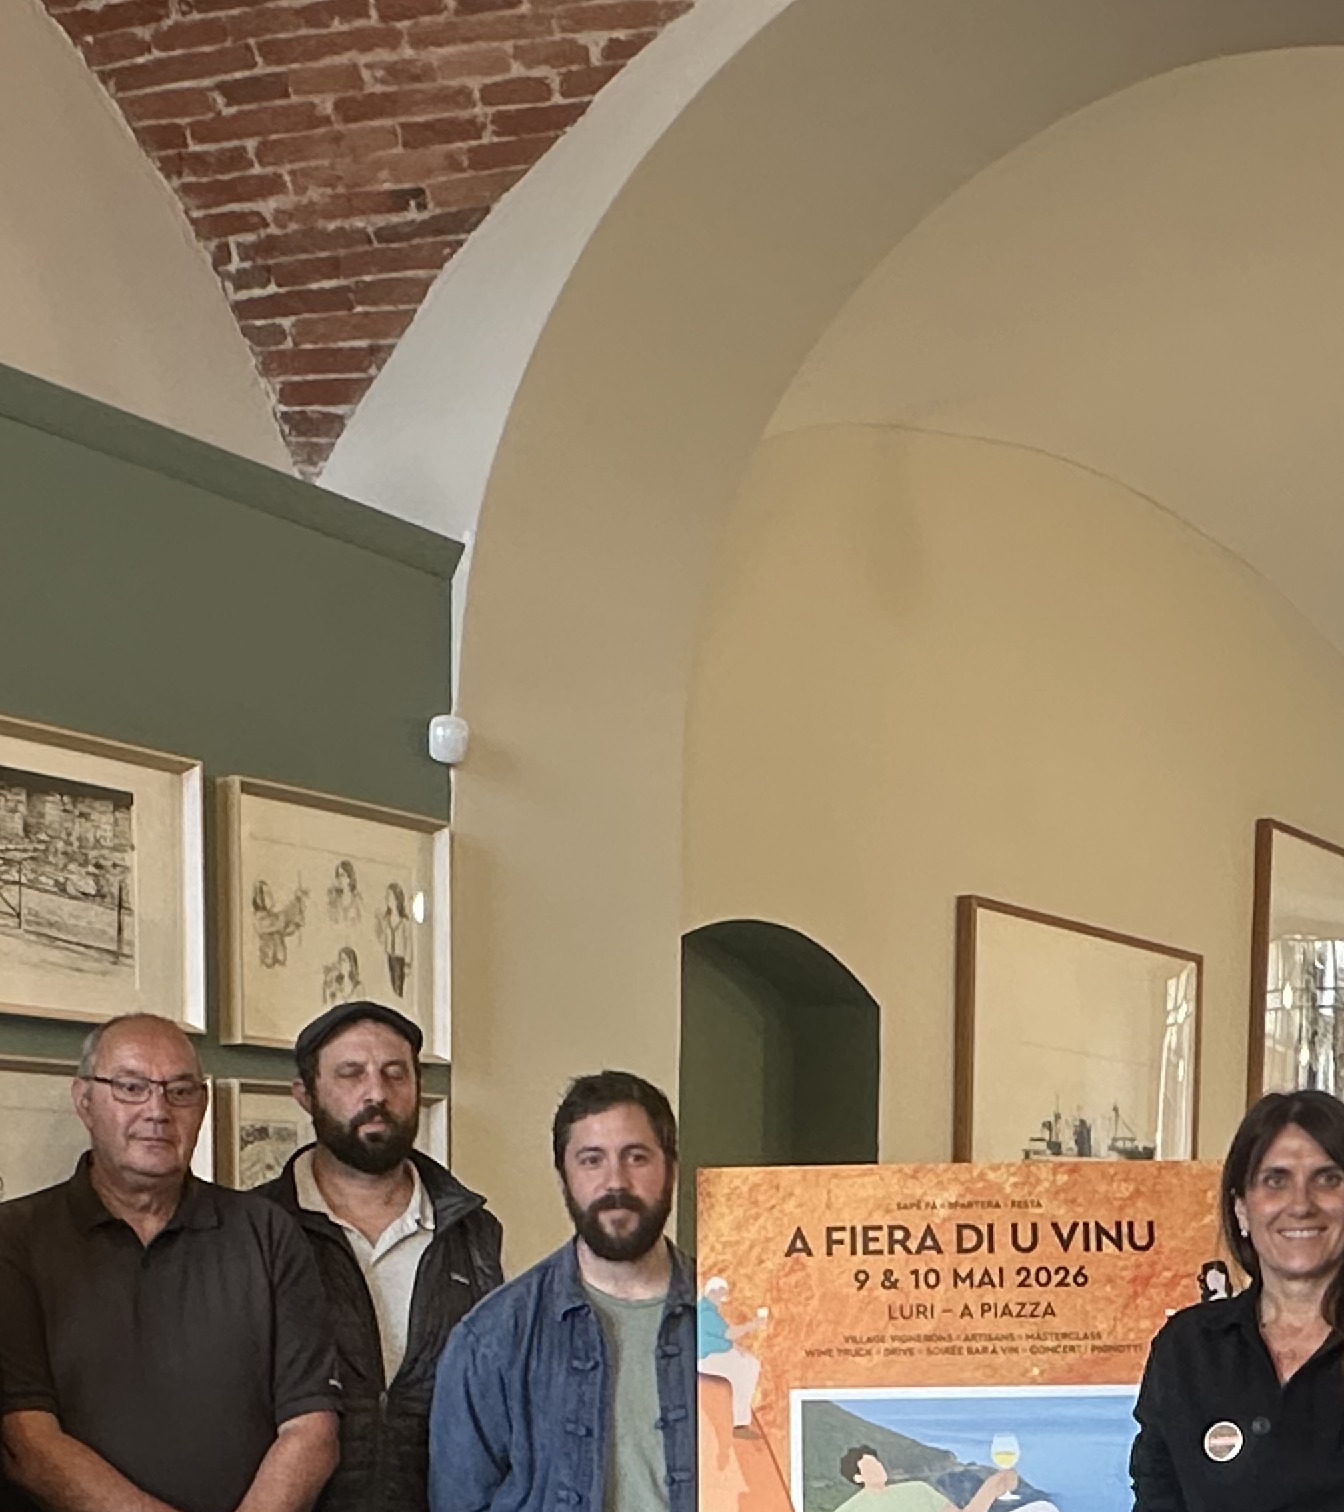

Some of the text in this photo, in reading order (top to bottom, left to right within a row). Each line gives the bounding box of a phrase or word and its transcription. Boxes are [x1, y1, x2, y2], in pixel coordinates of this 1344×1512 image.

[784, 1220, 1156, 1258] A FIERA DI U VINU
[854, 1265, 1089, 1291] 9 & 10 MAI 2026
[887, 1302, 935, 1321] LURI
[959, 1302, 974, 1320] A
[980, 1301, 1057, 1320] PIAZZA
[962, 1331, 1016, 1342] ARTISANS
[1025, 1330, 1103, 1342] MASTERCLASS
